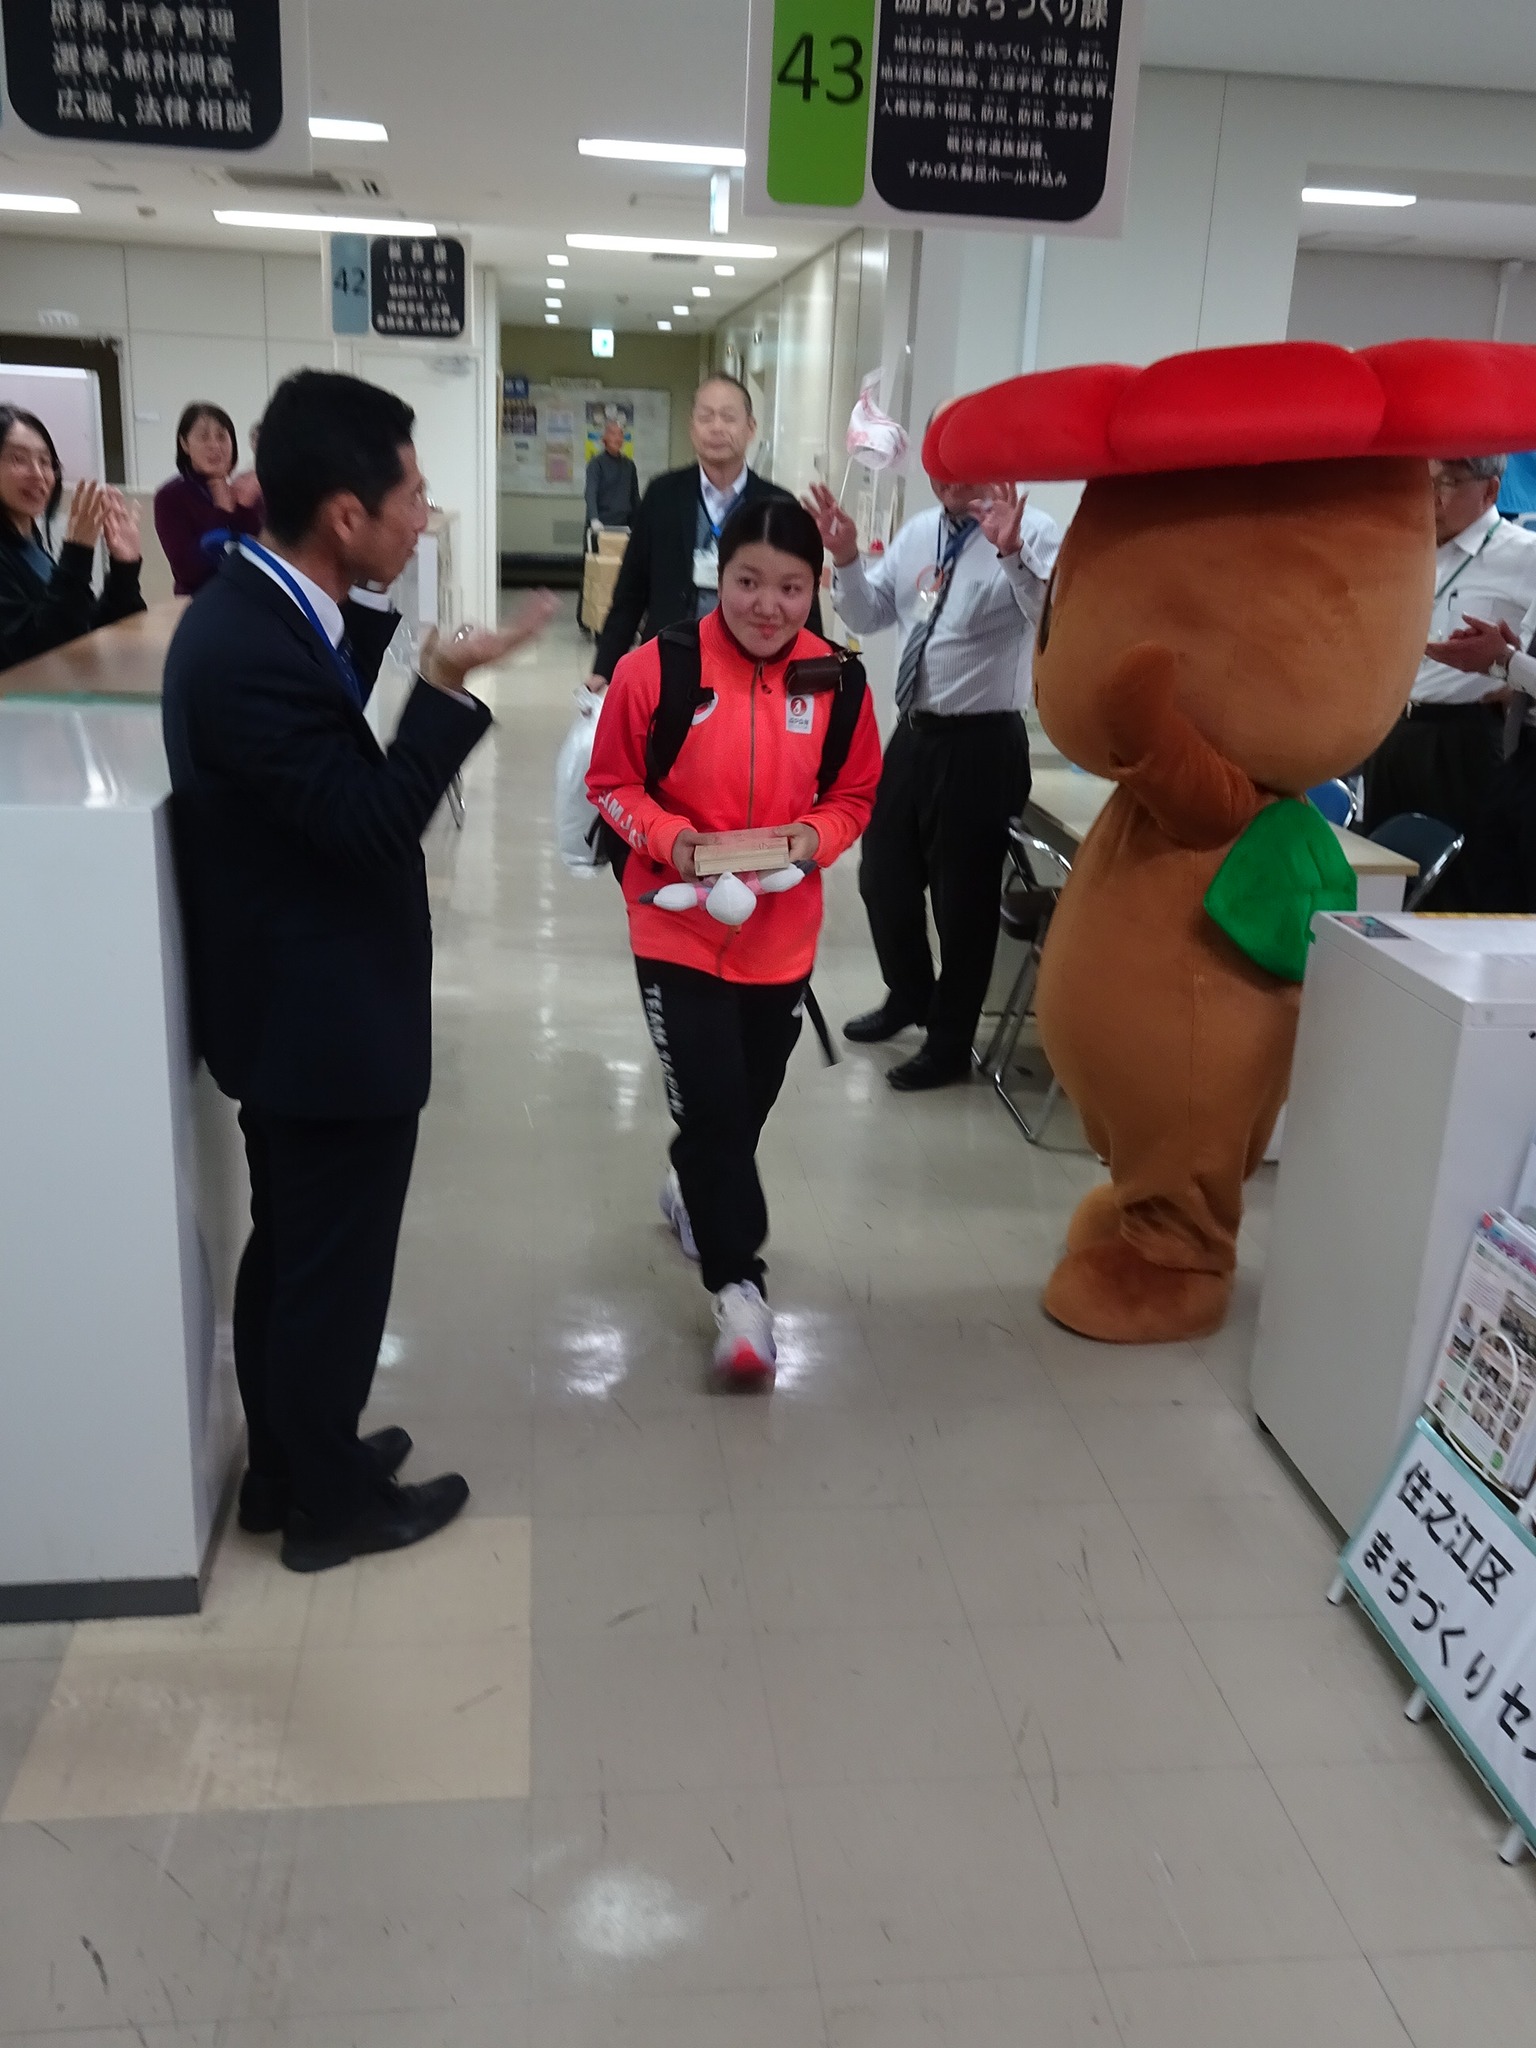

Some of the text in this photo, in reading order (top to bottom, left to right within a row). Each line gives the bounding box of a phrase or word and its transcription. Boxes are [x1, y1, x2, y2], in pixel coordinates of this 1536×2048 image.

[777, 33, 864, 103] 43
[334, 267, 366, 296] 42
[1397, 1460, 1514, 1607] 住之江区
